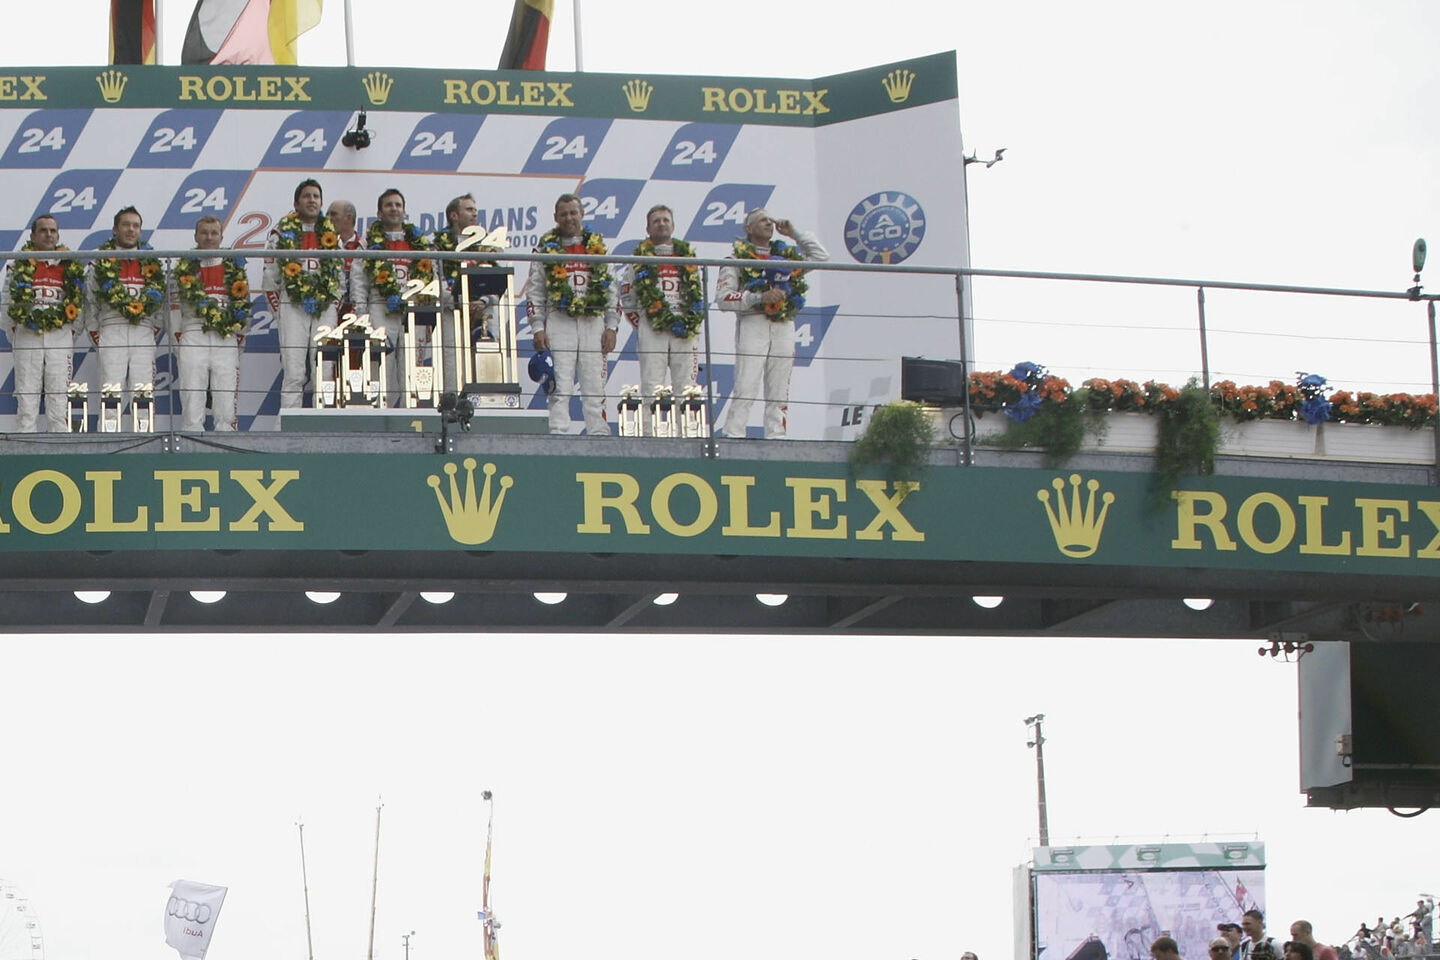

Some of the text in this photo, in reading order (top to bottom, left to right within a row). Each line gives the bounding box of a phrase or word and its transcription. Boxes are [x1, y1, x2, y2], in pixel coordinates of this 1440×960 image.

[179, 75, 312, 101] ROLEX
[443, 79, 575, 107] ROLEX
[702, 87, 830, 115] ROLEX
[17, 126, 66, 153] 24
[148, 126, 197, 153] 24
[279, 128, 328, 154] 24
[409, 131, 458, 156] 24
[541, 135, 588, 160] 24
[671, 140, 717, 165] 24
[49, 186, 97, 214] 24
[180, 186, 228, 213] 24
[581, 196, 620, 220] 24
[702, 200, 749, 226] 24
[575, 470, 926, 543] ROLEX
